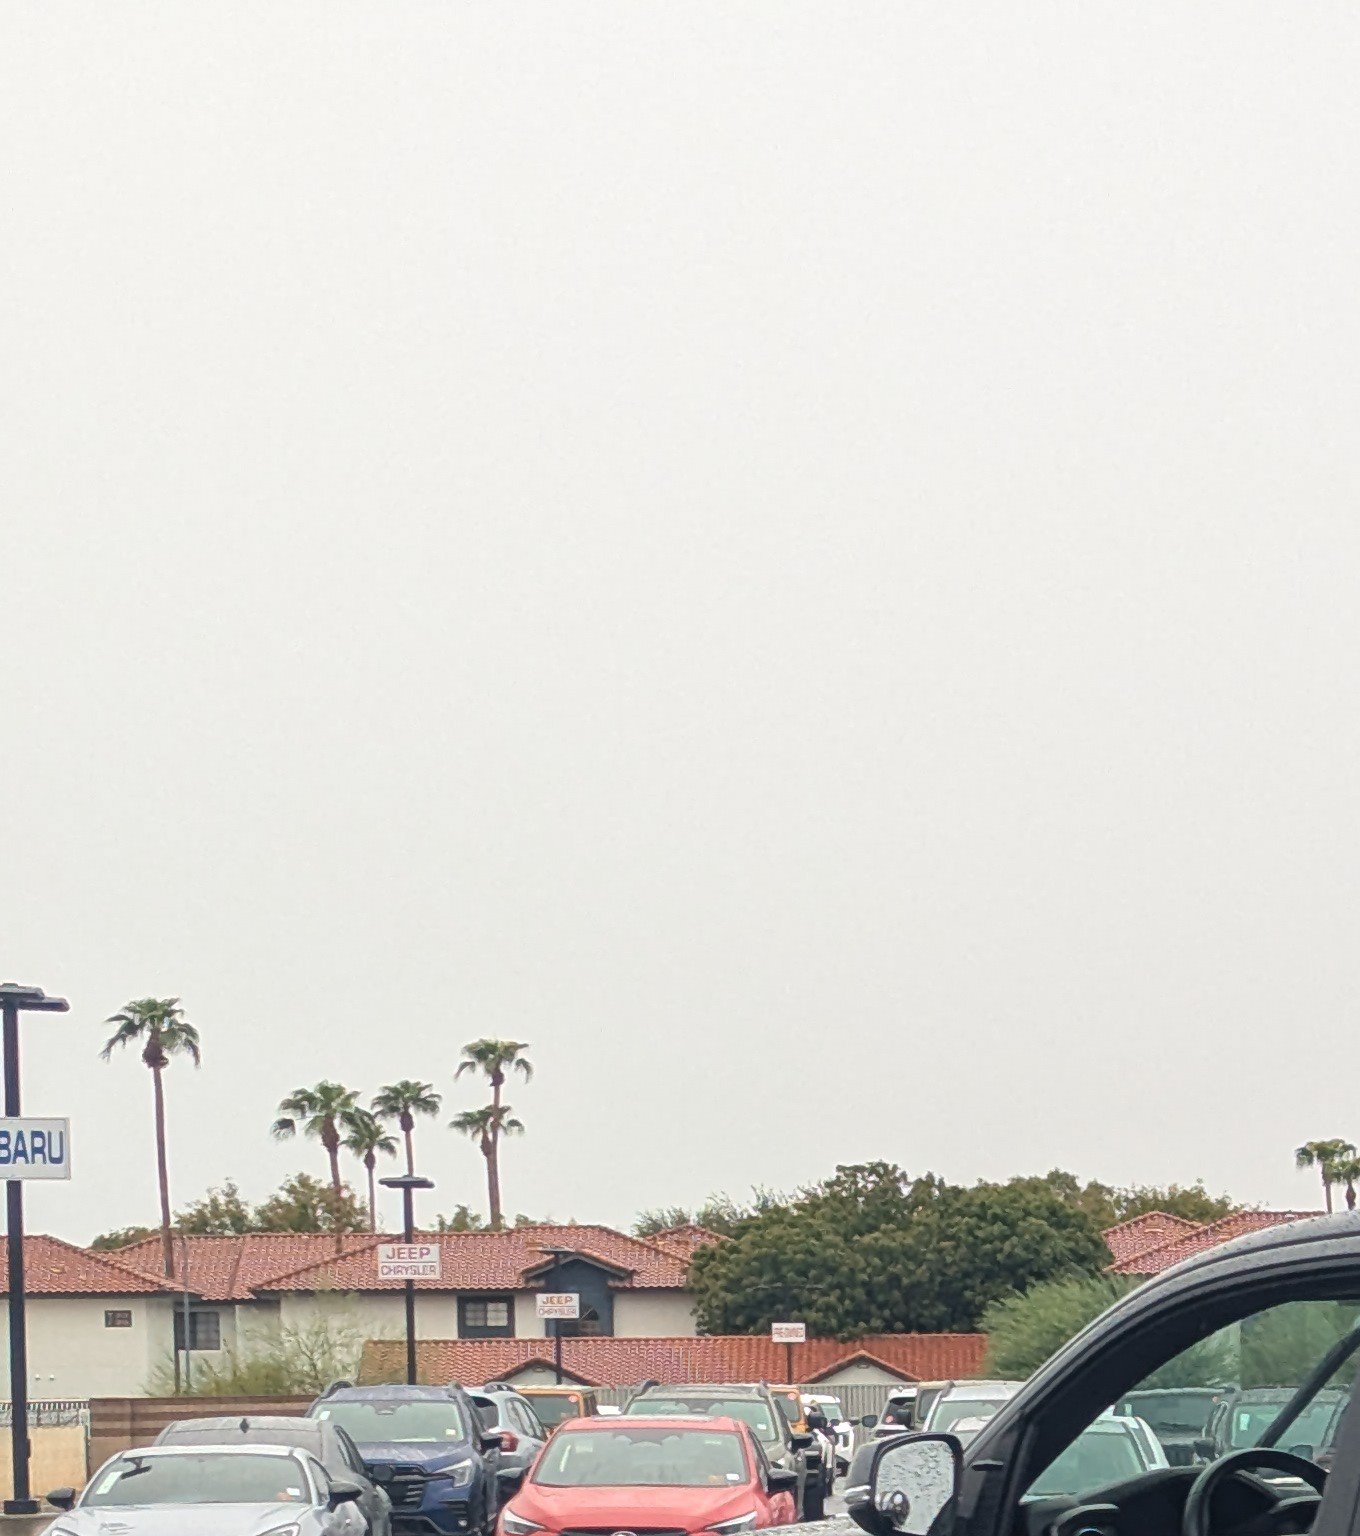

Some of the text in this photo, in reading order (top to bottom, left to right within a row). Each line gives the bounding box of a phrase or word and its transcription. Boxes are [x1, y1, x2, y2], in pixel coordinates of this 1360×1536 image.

[386, 1246, 431, 1260] JEEP
[380, 1264, 437, 1276] CHRYSLER
[542, 1295, 573, 1305] JEEP
